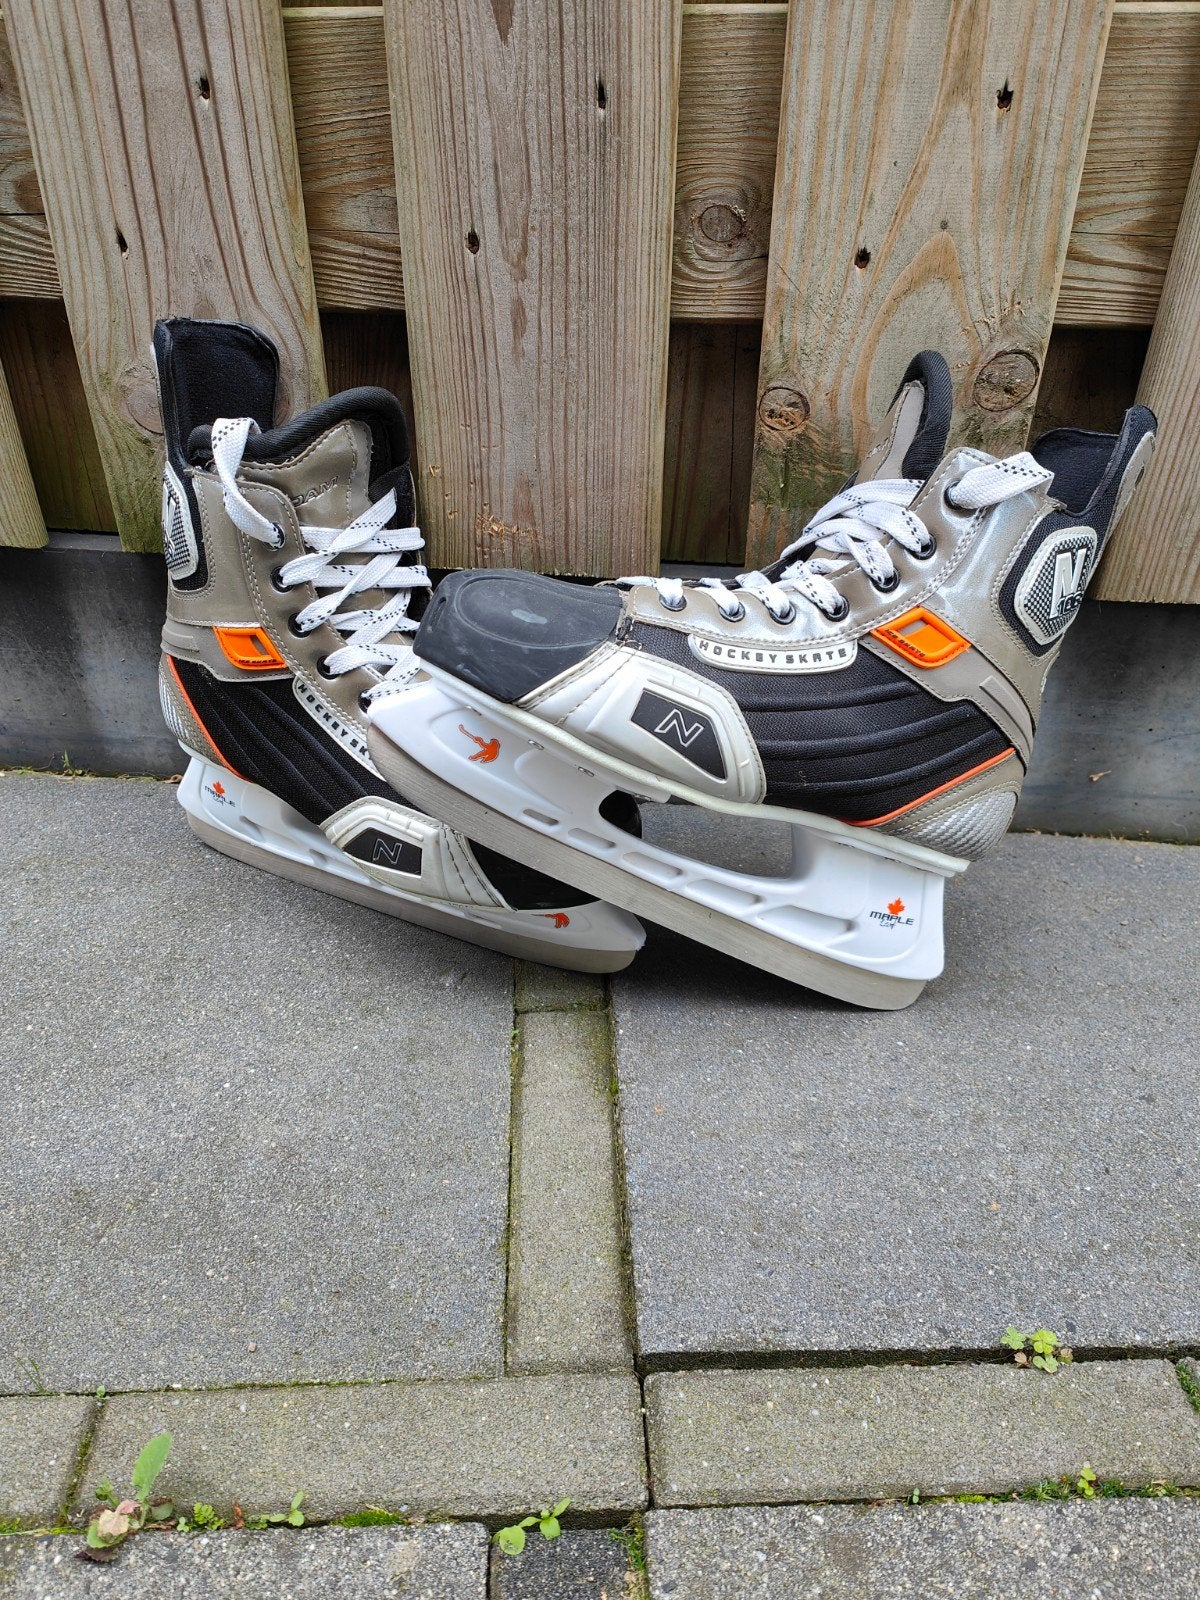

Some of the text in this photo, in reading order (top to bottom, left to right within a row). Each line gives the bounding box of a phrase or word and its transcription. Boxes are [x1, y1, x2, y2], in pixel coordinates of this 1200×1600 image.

[1049, 548, 1087, 619] N
[699, 640, 847, 664] HOCKEY SKATE
[298, 683, 349, 738] HOCKEY
[654, 708, 704, 748] N
[372, 838, 402, 865] N
[869, 910, 915, 926] MAPLE
